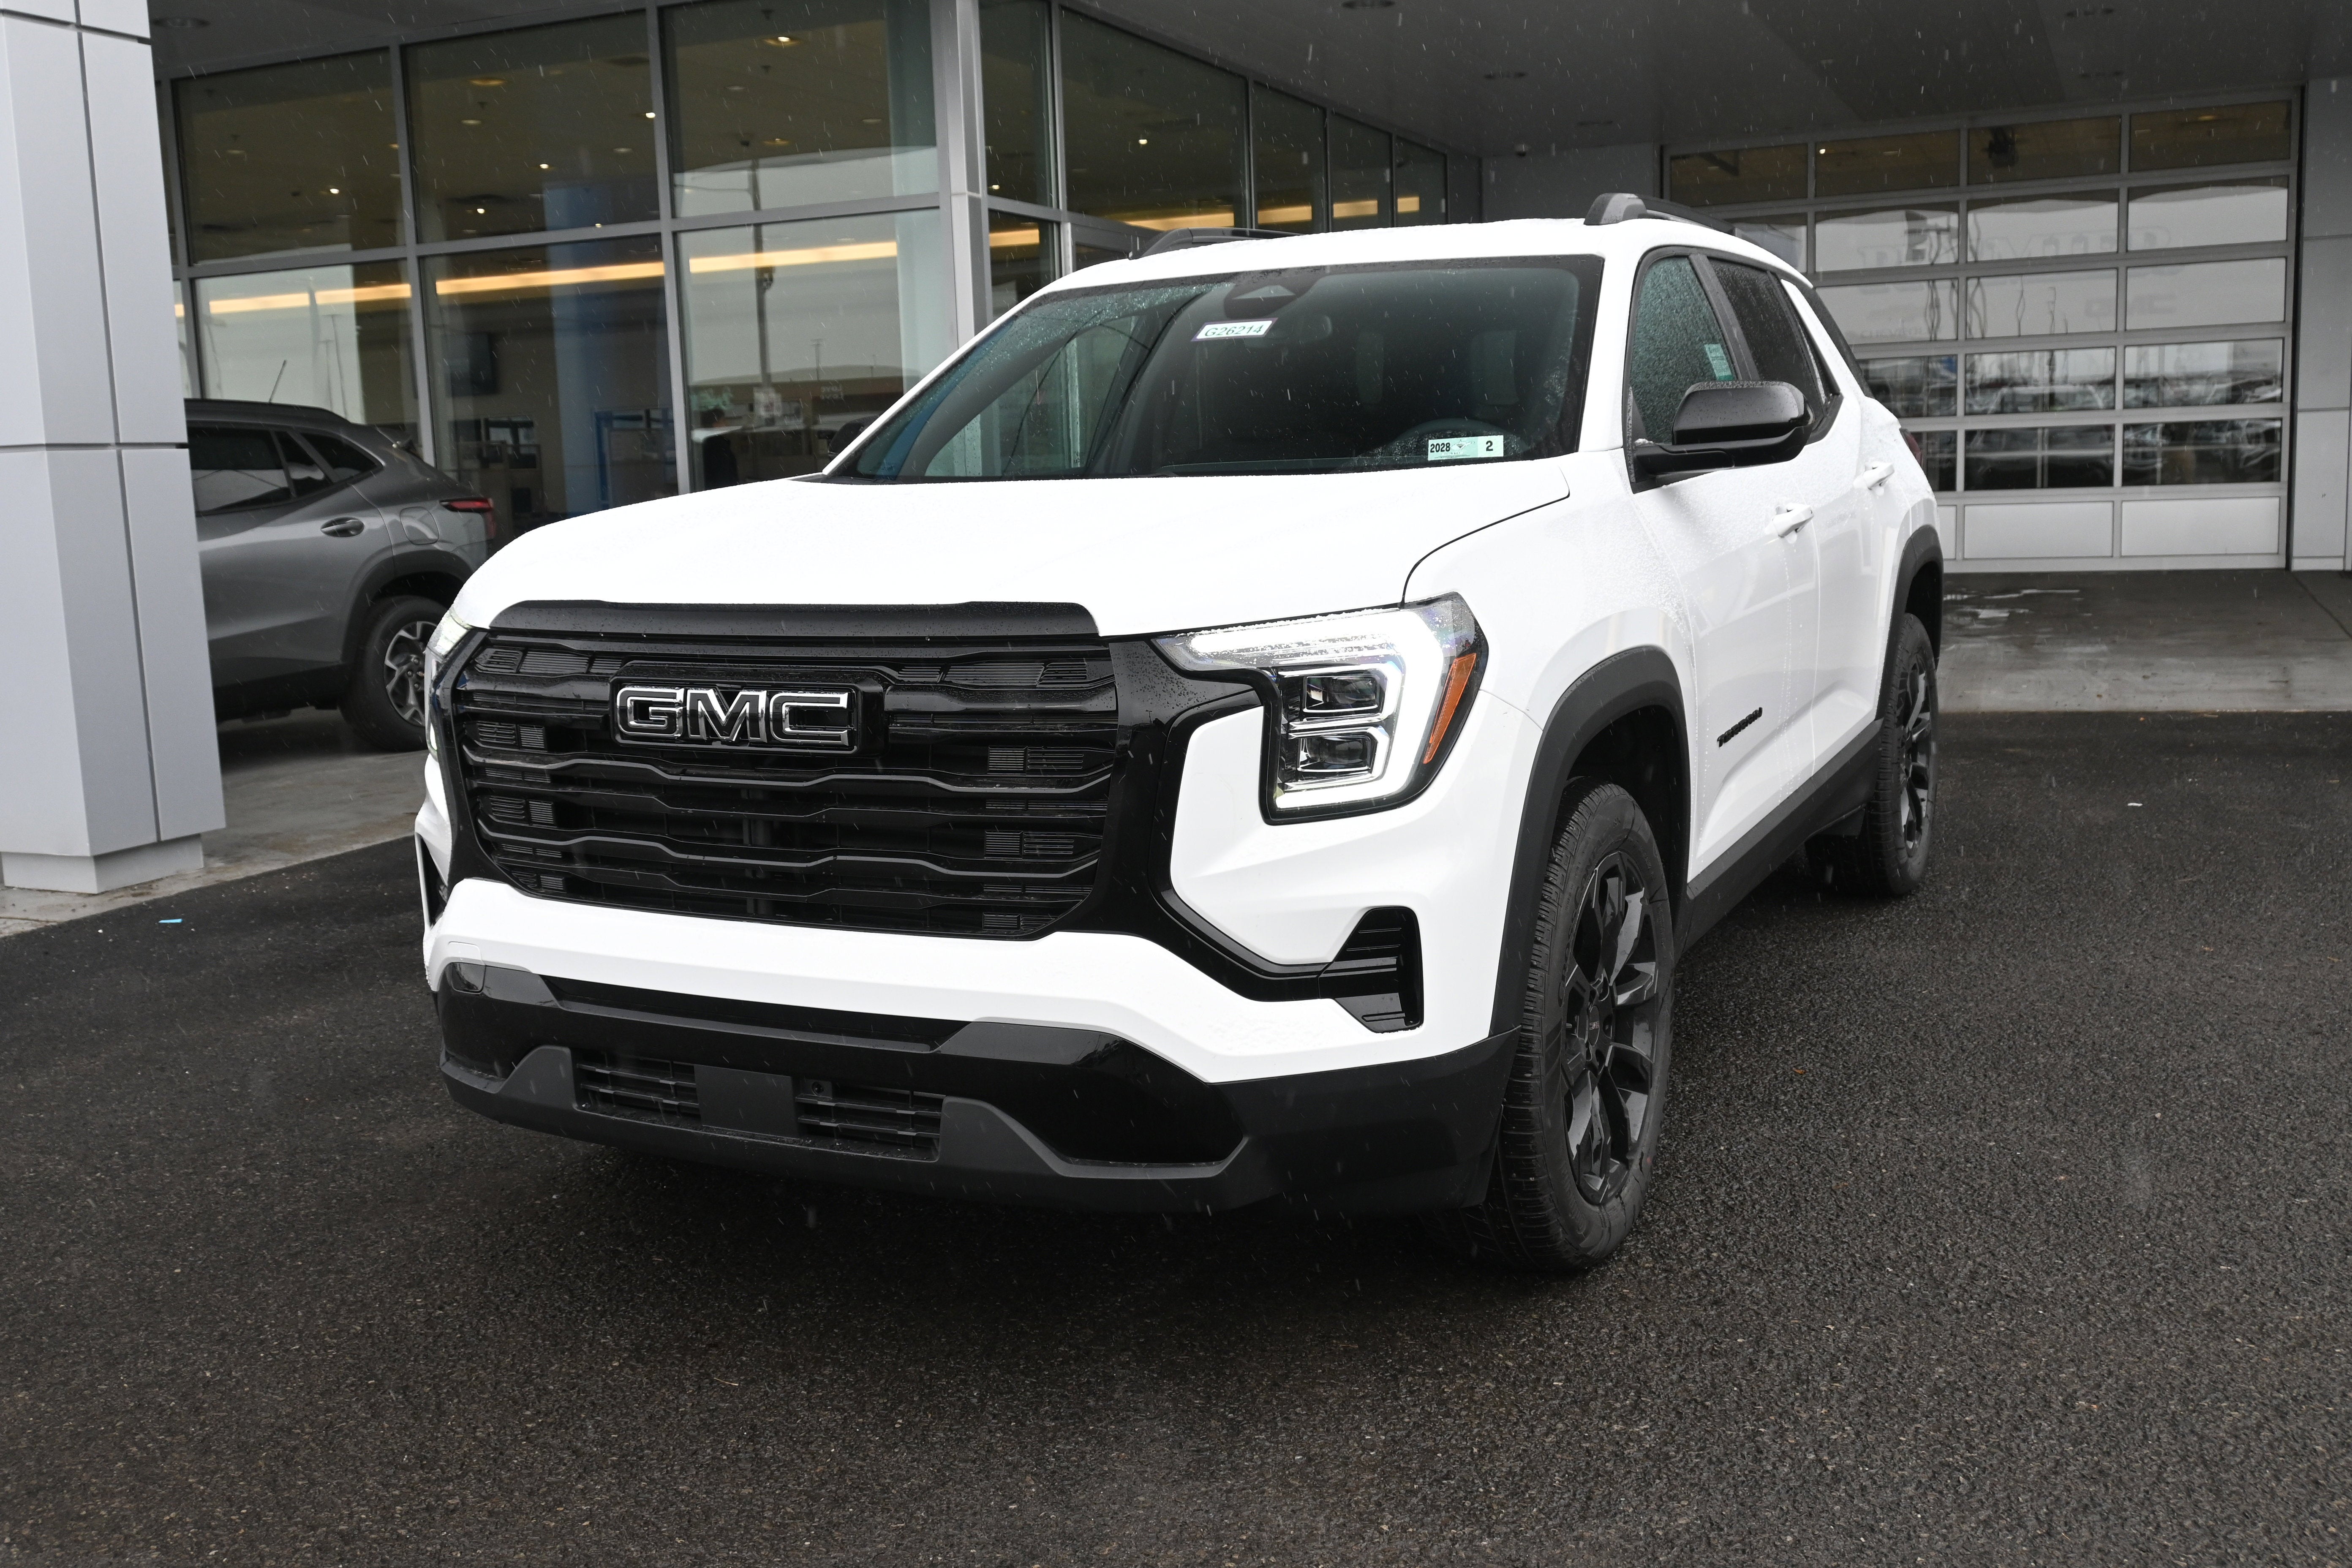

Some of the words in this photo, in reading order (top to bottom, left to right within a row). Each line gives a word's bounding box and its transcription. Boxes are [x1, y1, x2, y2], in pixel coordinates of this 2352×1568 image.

[1205, 324, 1263, 337] G26214
[1430, 442, 1451, 453] 2028
[1486, 440, 1494, 451] 2
[618, 686, 849, 746] GMC
